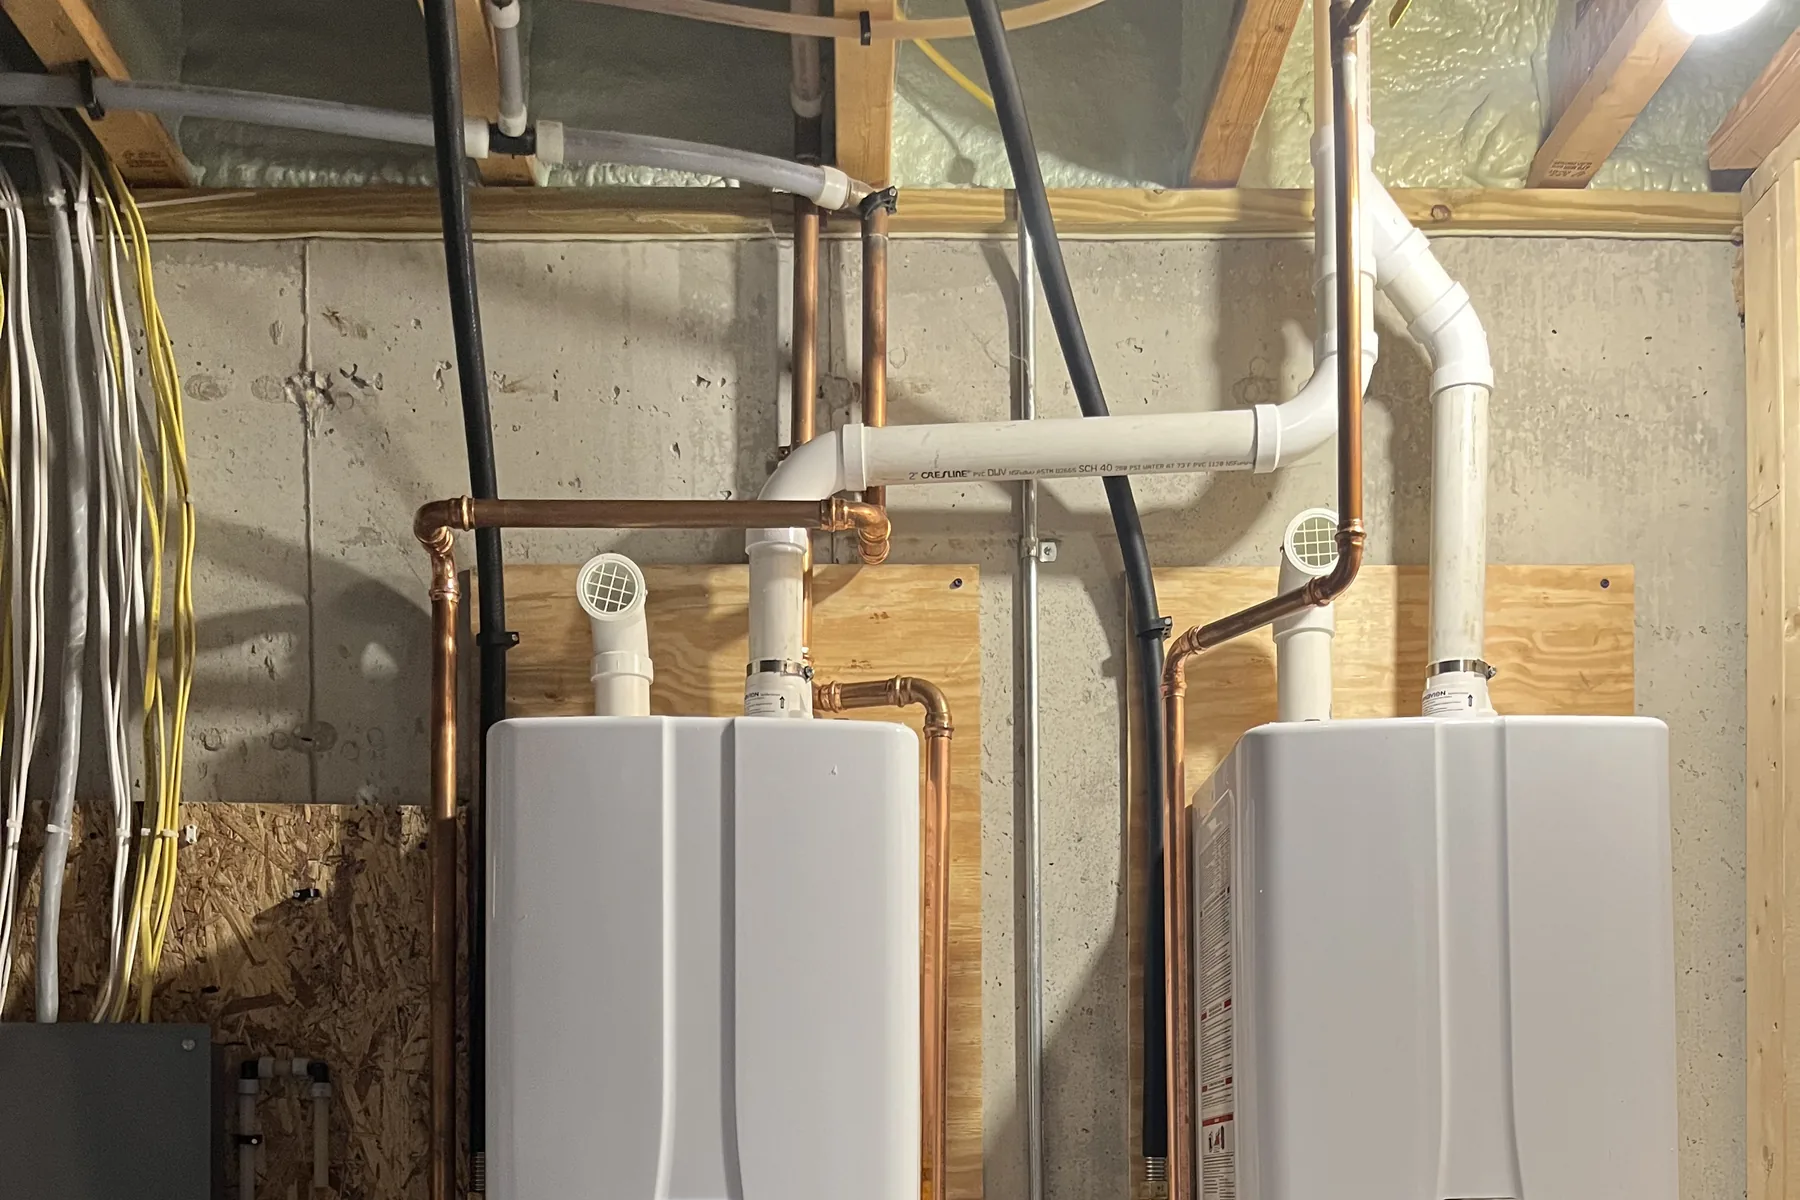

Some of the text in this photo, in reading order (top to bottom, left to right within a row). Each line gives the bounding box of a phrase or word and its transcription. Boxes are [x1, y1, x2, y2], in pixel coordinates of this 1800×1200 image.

[987, 468, 1006, 476] DWV
[1079, 464, 1098, 473] SCH
[1100, 463, 1113, 472] 40
